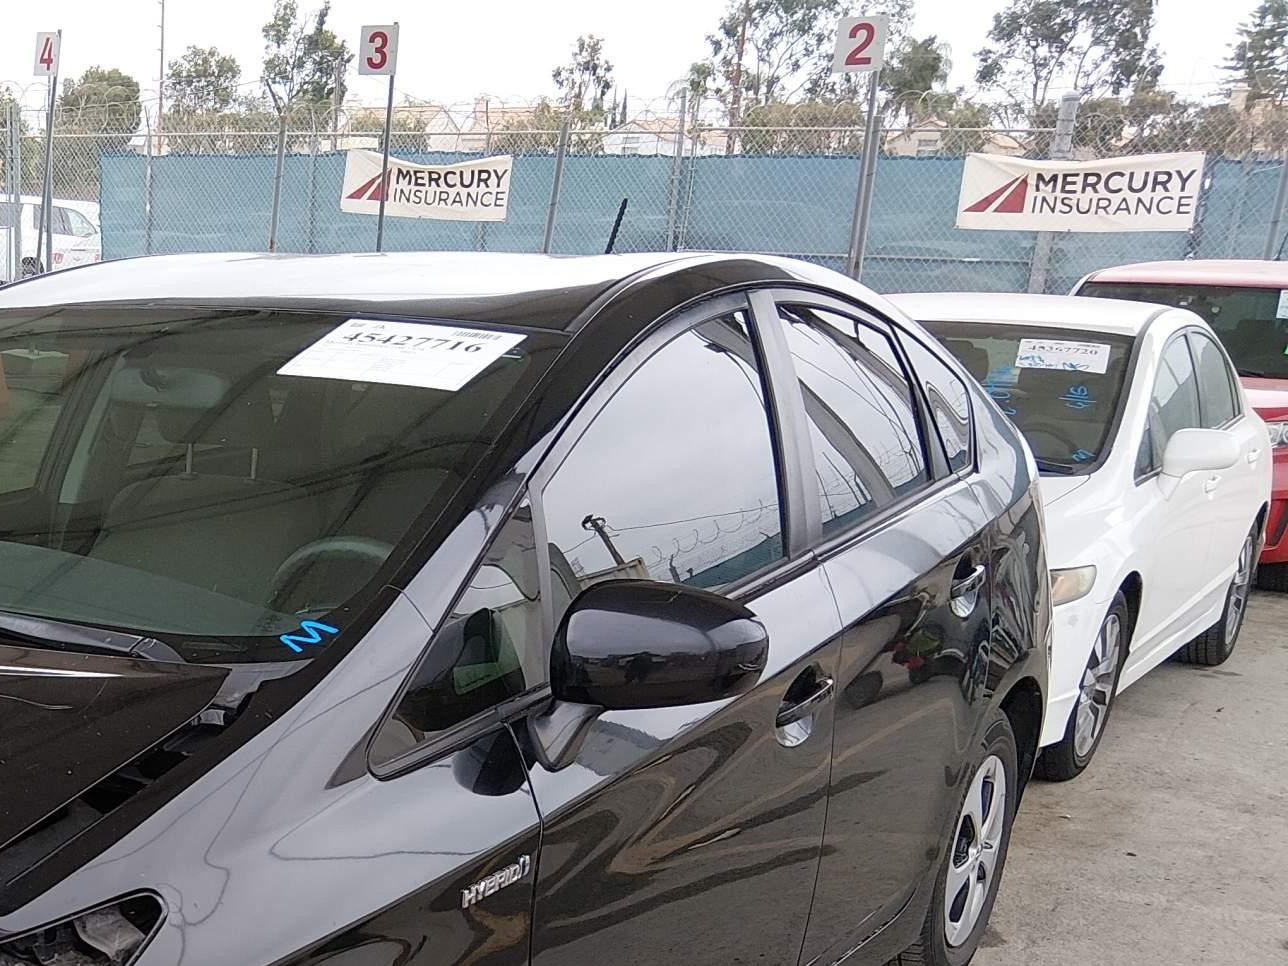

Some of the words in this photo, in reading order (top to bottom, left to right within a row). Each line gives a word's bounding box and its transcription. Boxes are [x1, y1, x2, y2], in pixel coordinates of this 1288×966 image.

[39, 37, 53, 71] 4
[366, 31, 389, 70] 3
[845, 22, 875, 66] 2
[395, 167, 508, 189] MERCURY
[1035, 169, 1198, 194] MERCURY
[393, 188, 506, 208] INSURANCE
[1031, 195, 1193, 216] INSURANCE
[343, 331, 487, 353] 45427716
[460, 863, 521, 909] HYBRID
